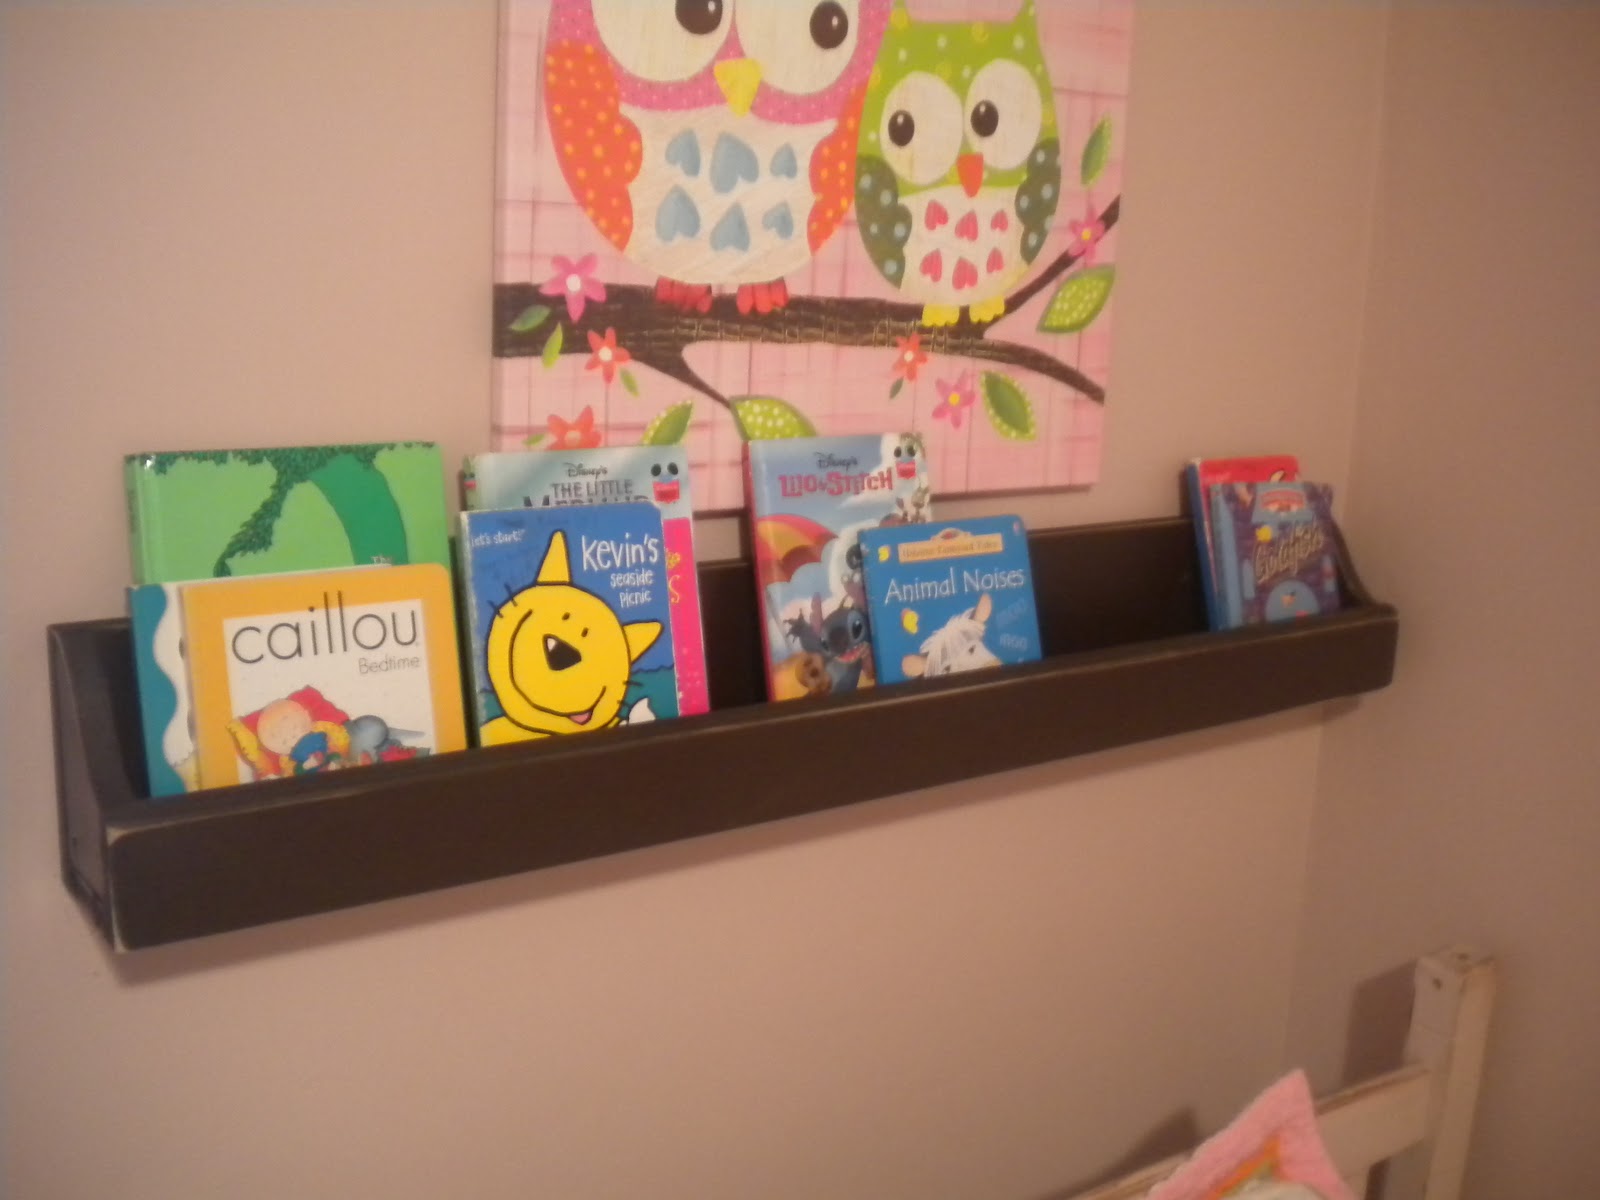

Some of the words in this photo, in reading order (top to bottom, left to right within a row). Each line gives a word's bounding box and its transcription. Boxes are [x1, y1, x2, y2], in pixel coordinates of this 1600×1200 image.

[563, 462, 609, 480] Disney's
[551, 482, 583, 498] THE
[585, 479, 633, 496] LITTLE
[610, 568, 654, 589] seaside
[884, 567, 956, 606] Animal
[963, 567, 1025, 593] Noises
[619, 588, 653, 609] picnic
[231, 590, 418, 664] caillou
[358, 655, 421, 675] Bedtime
